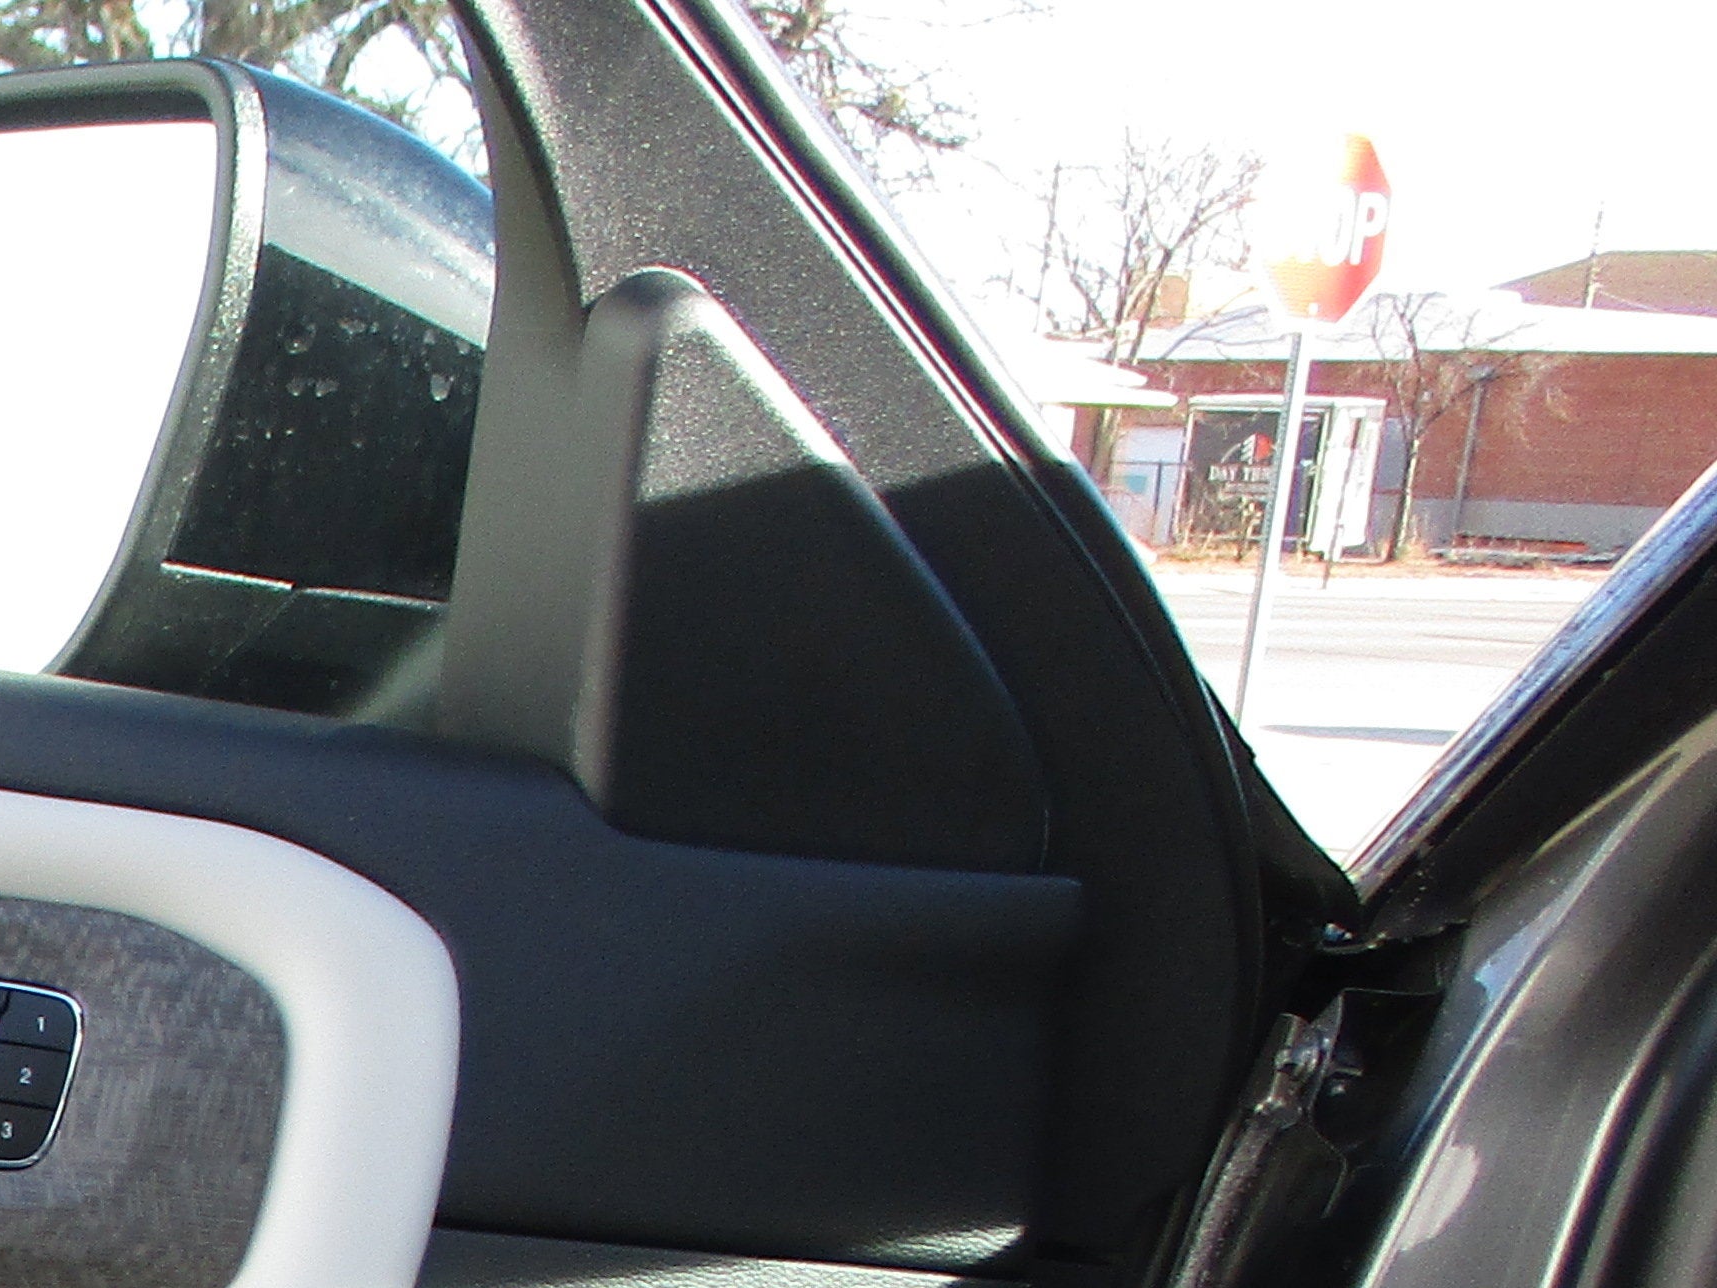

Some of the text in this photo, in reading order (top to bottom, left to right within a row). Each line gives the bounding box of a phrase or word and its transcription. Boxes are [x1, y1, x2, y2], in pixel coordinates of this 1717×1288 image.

[37, 1016, 45, 1032] 1
[19, 1067, 31, 1084] 2
[1, 1121, 13, 1139] 3
